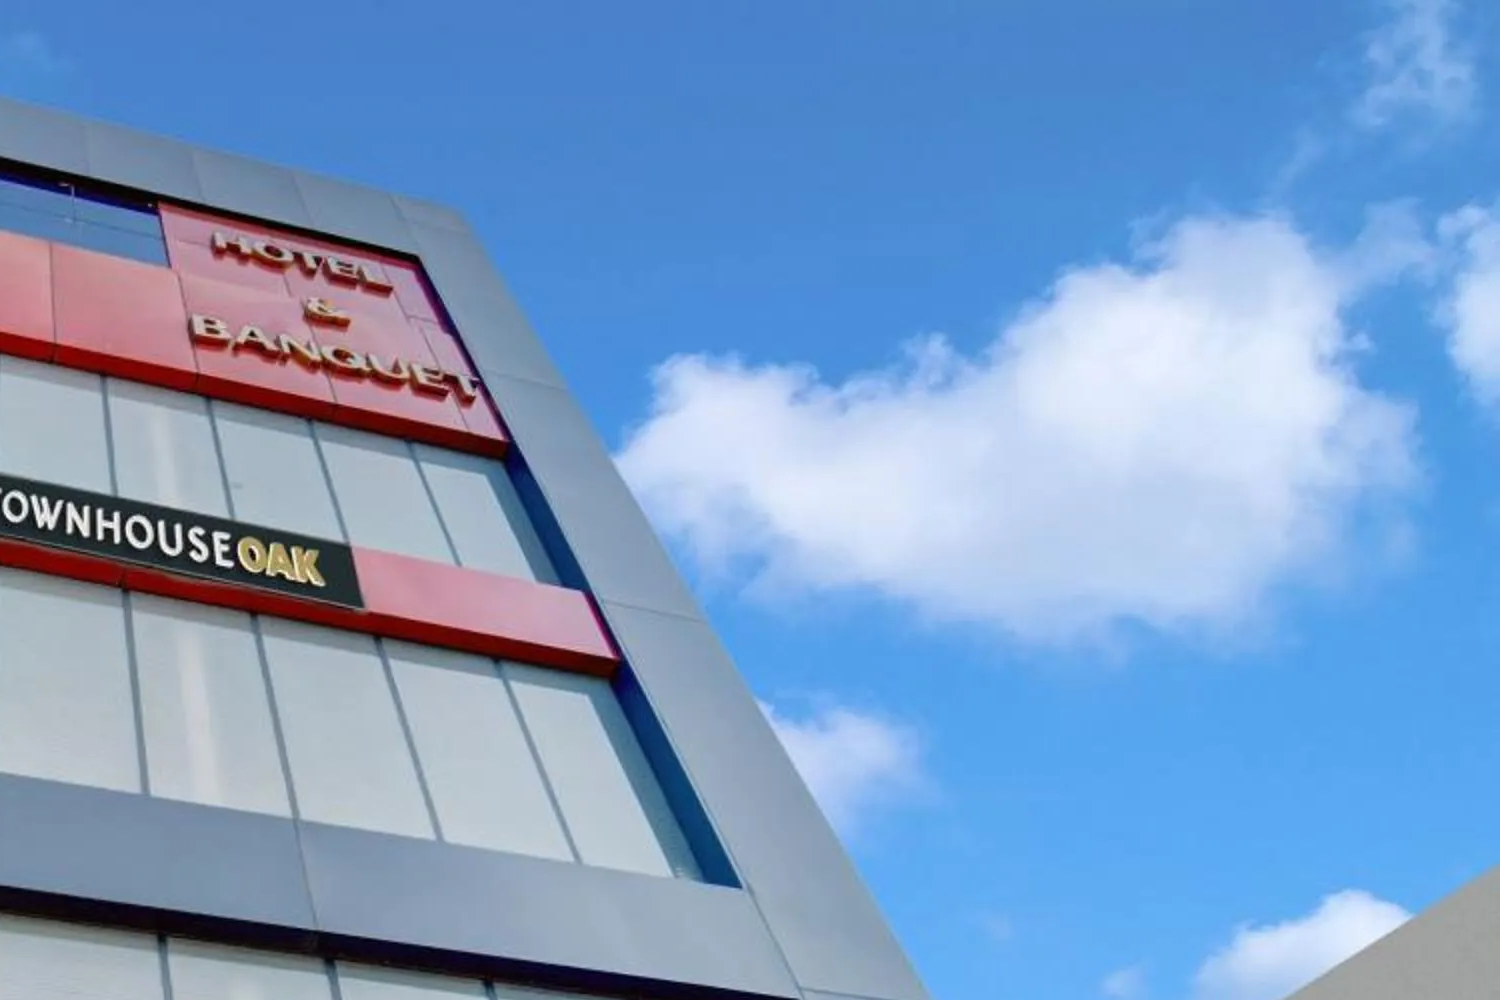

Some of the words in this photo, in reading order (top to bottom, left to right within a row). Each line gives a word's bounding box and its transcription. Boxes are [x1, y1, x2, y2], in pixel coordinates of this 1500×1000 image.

[211, 231, 393, 297] HOTEL
[304, 296, 350, 326] &
[189, 314, 480, 406] BANQUET
[237, 536, 326, 587] OAK
